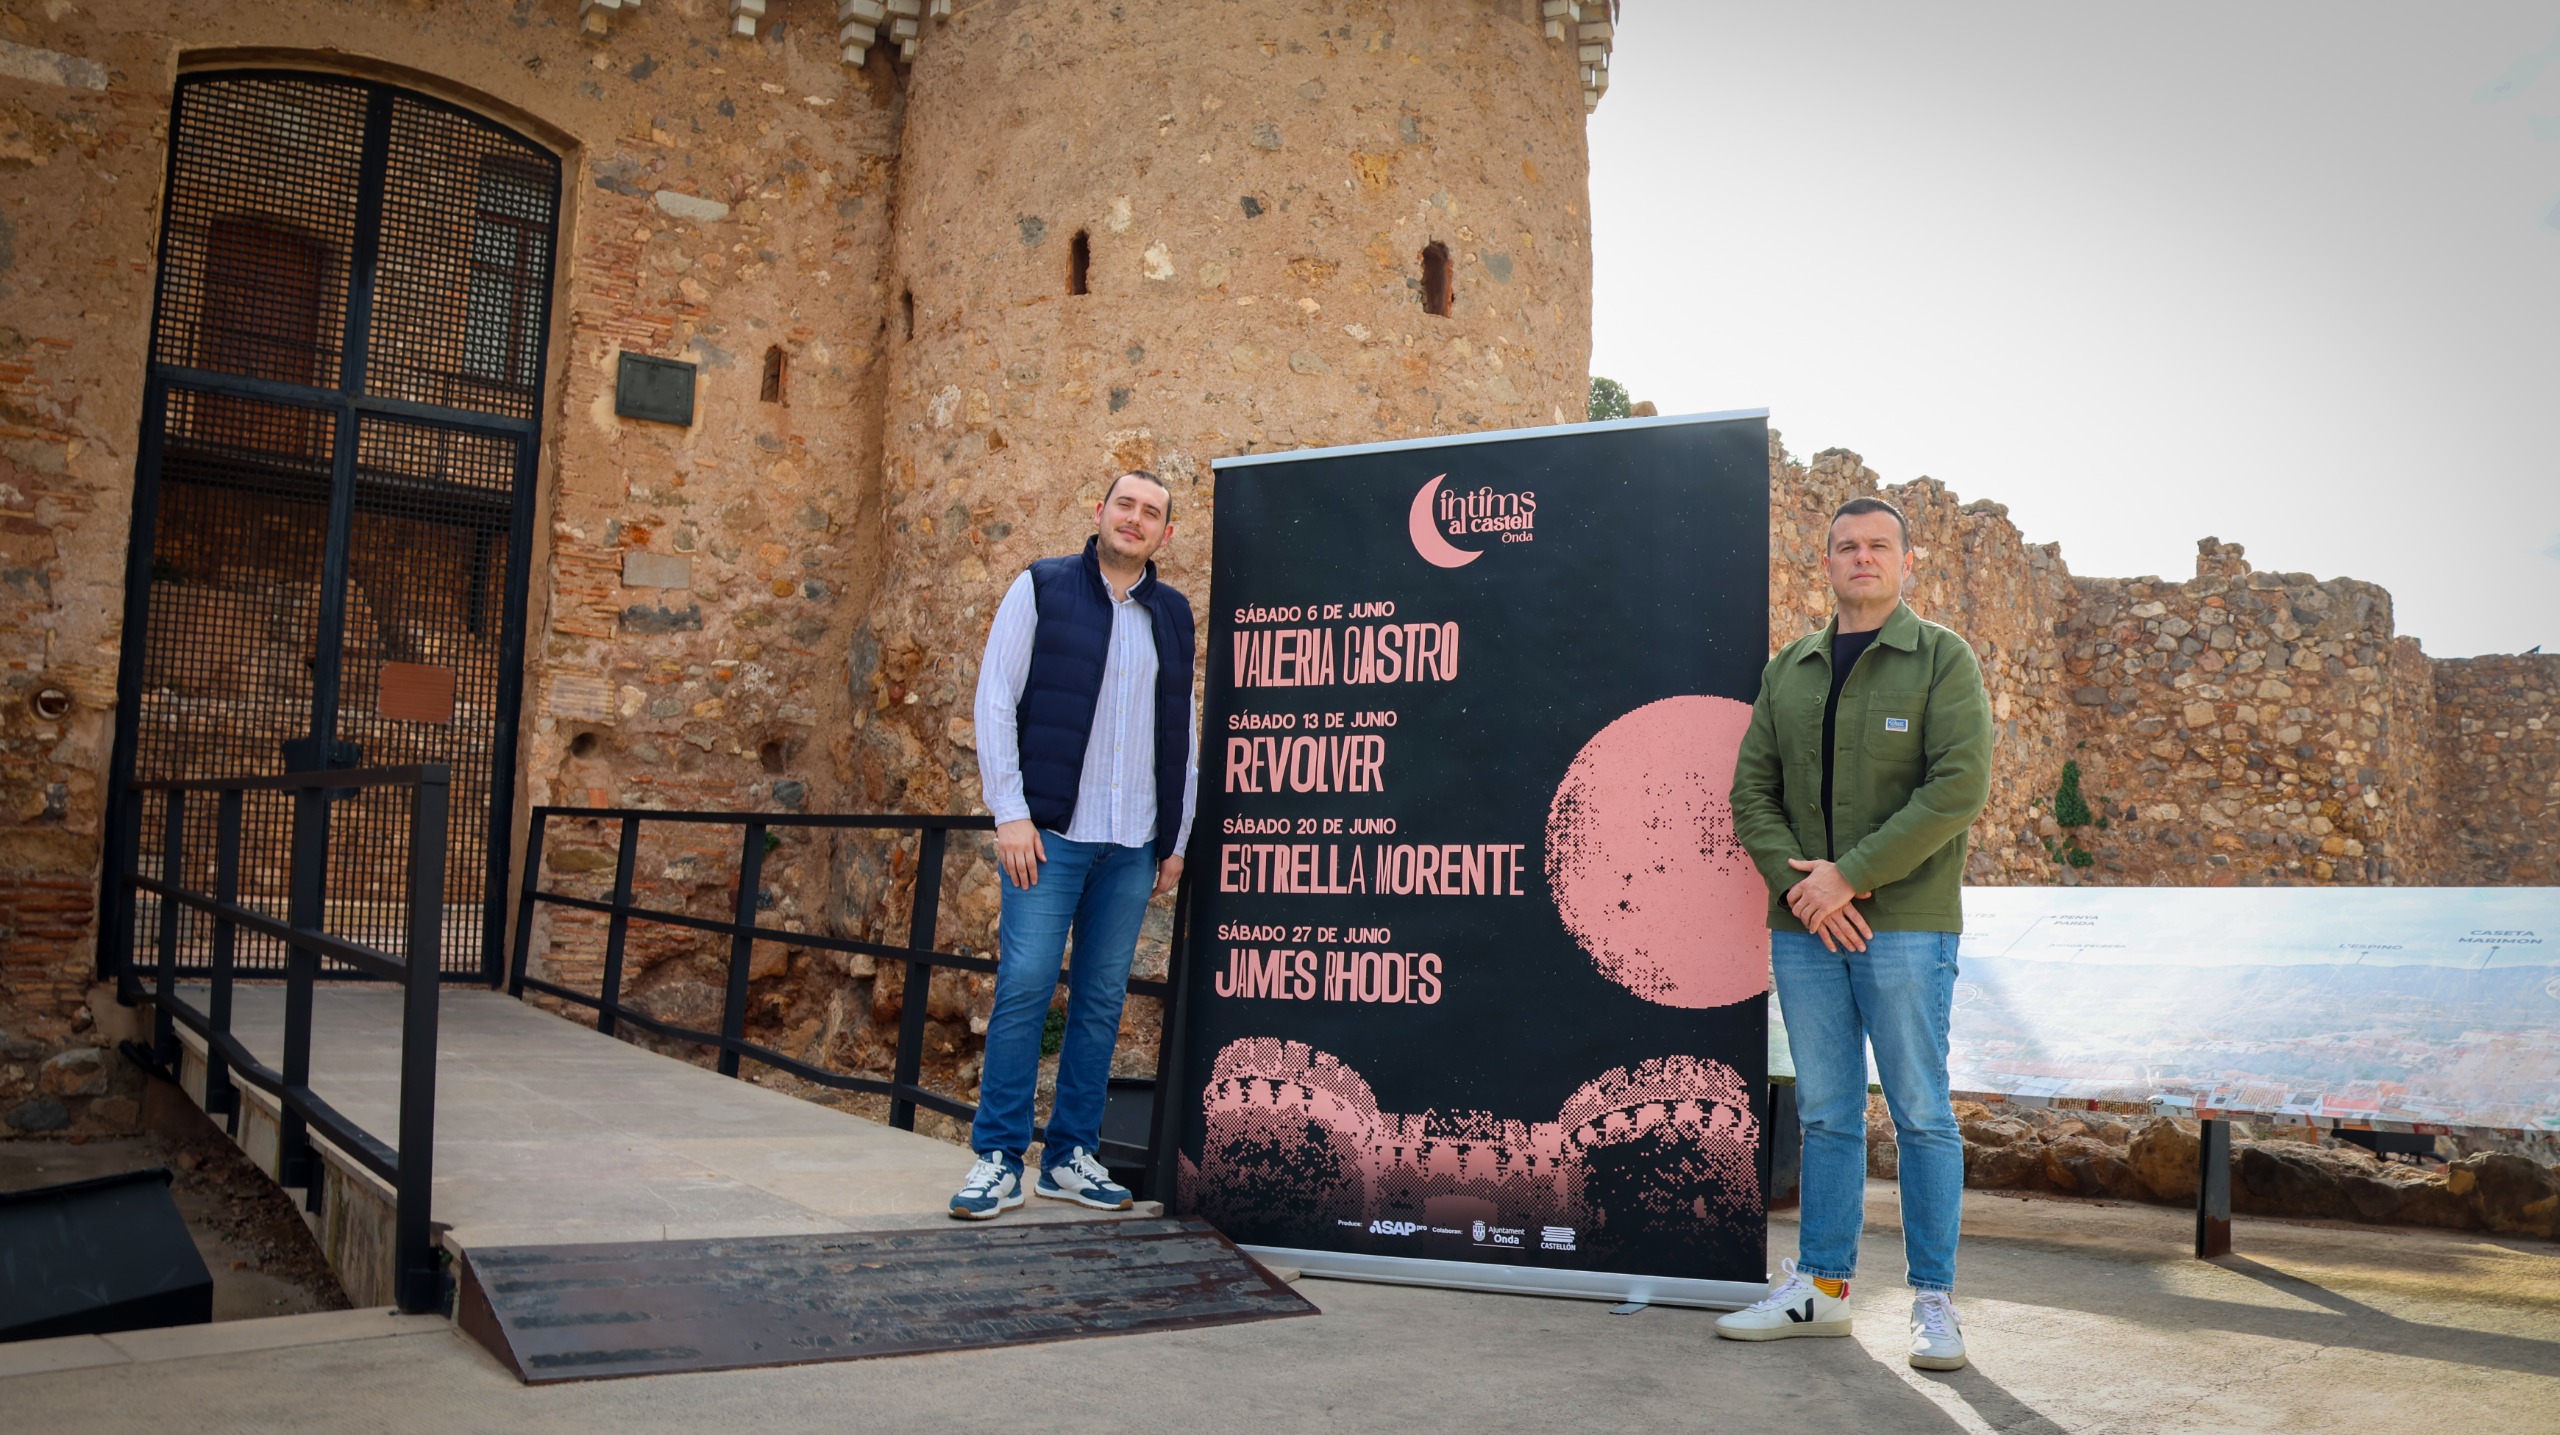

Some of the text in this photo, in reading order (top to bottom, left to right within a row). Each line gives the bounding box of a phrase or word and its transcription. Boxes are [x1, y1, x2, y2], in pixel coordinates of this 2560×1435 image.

[1449, 512, 1535, 535] al castell
[1501, 531, 1533, 544] Onda
[1234, 601, 1395, 624] SÁBADO 6 DE JUNIO
[1233, 621, 1459, 688] VALERIA CASTRO
[1228, 709, 1398, 730] SÁBADO 13 DE JUNIO
[1225, 734, 1385, 793] REVOLVER
[1222, 813, 1397, 836] SÁBADO 20 DE JUNIO
[1219, 843, 1526, 896] ESTRELLA MORENTE
[1217, 920, 1391, 944] SÁBADO 27 DE JUNIO
[2457, 937, 2544, 945] MARIMON
[1215, 948, 1443, 1005] JAMES RHODES
[1337, 1219, 1363, 1228] Produce:
[1369, 1220, 1416, 1236] ASAP
[1432, 1226, 1463, 1235] Colaboran:
[1488, 1226, 1525, 1236] Ajuntament
[1493, 1234, 1520, 1245] Onda
[1540, 1242, 1576, 1251] CASTELLÓN
